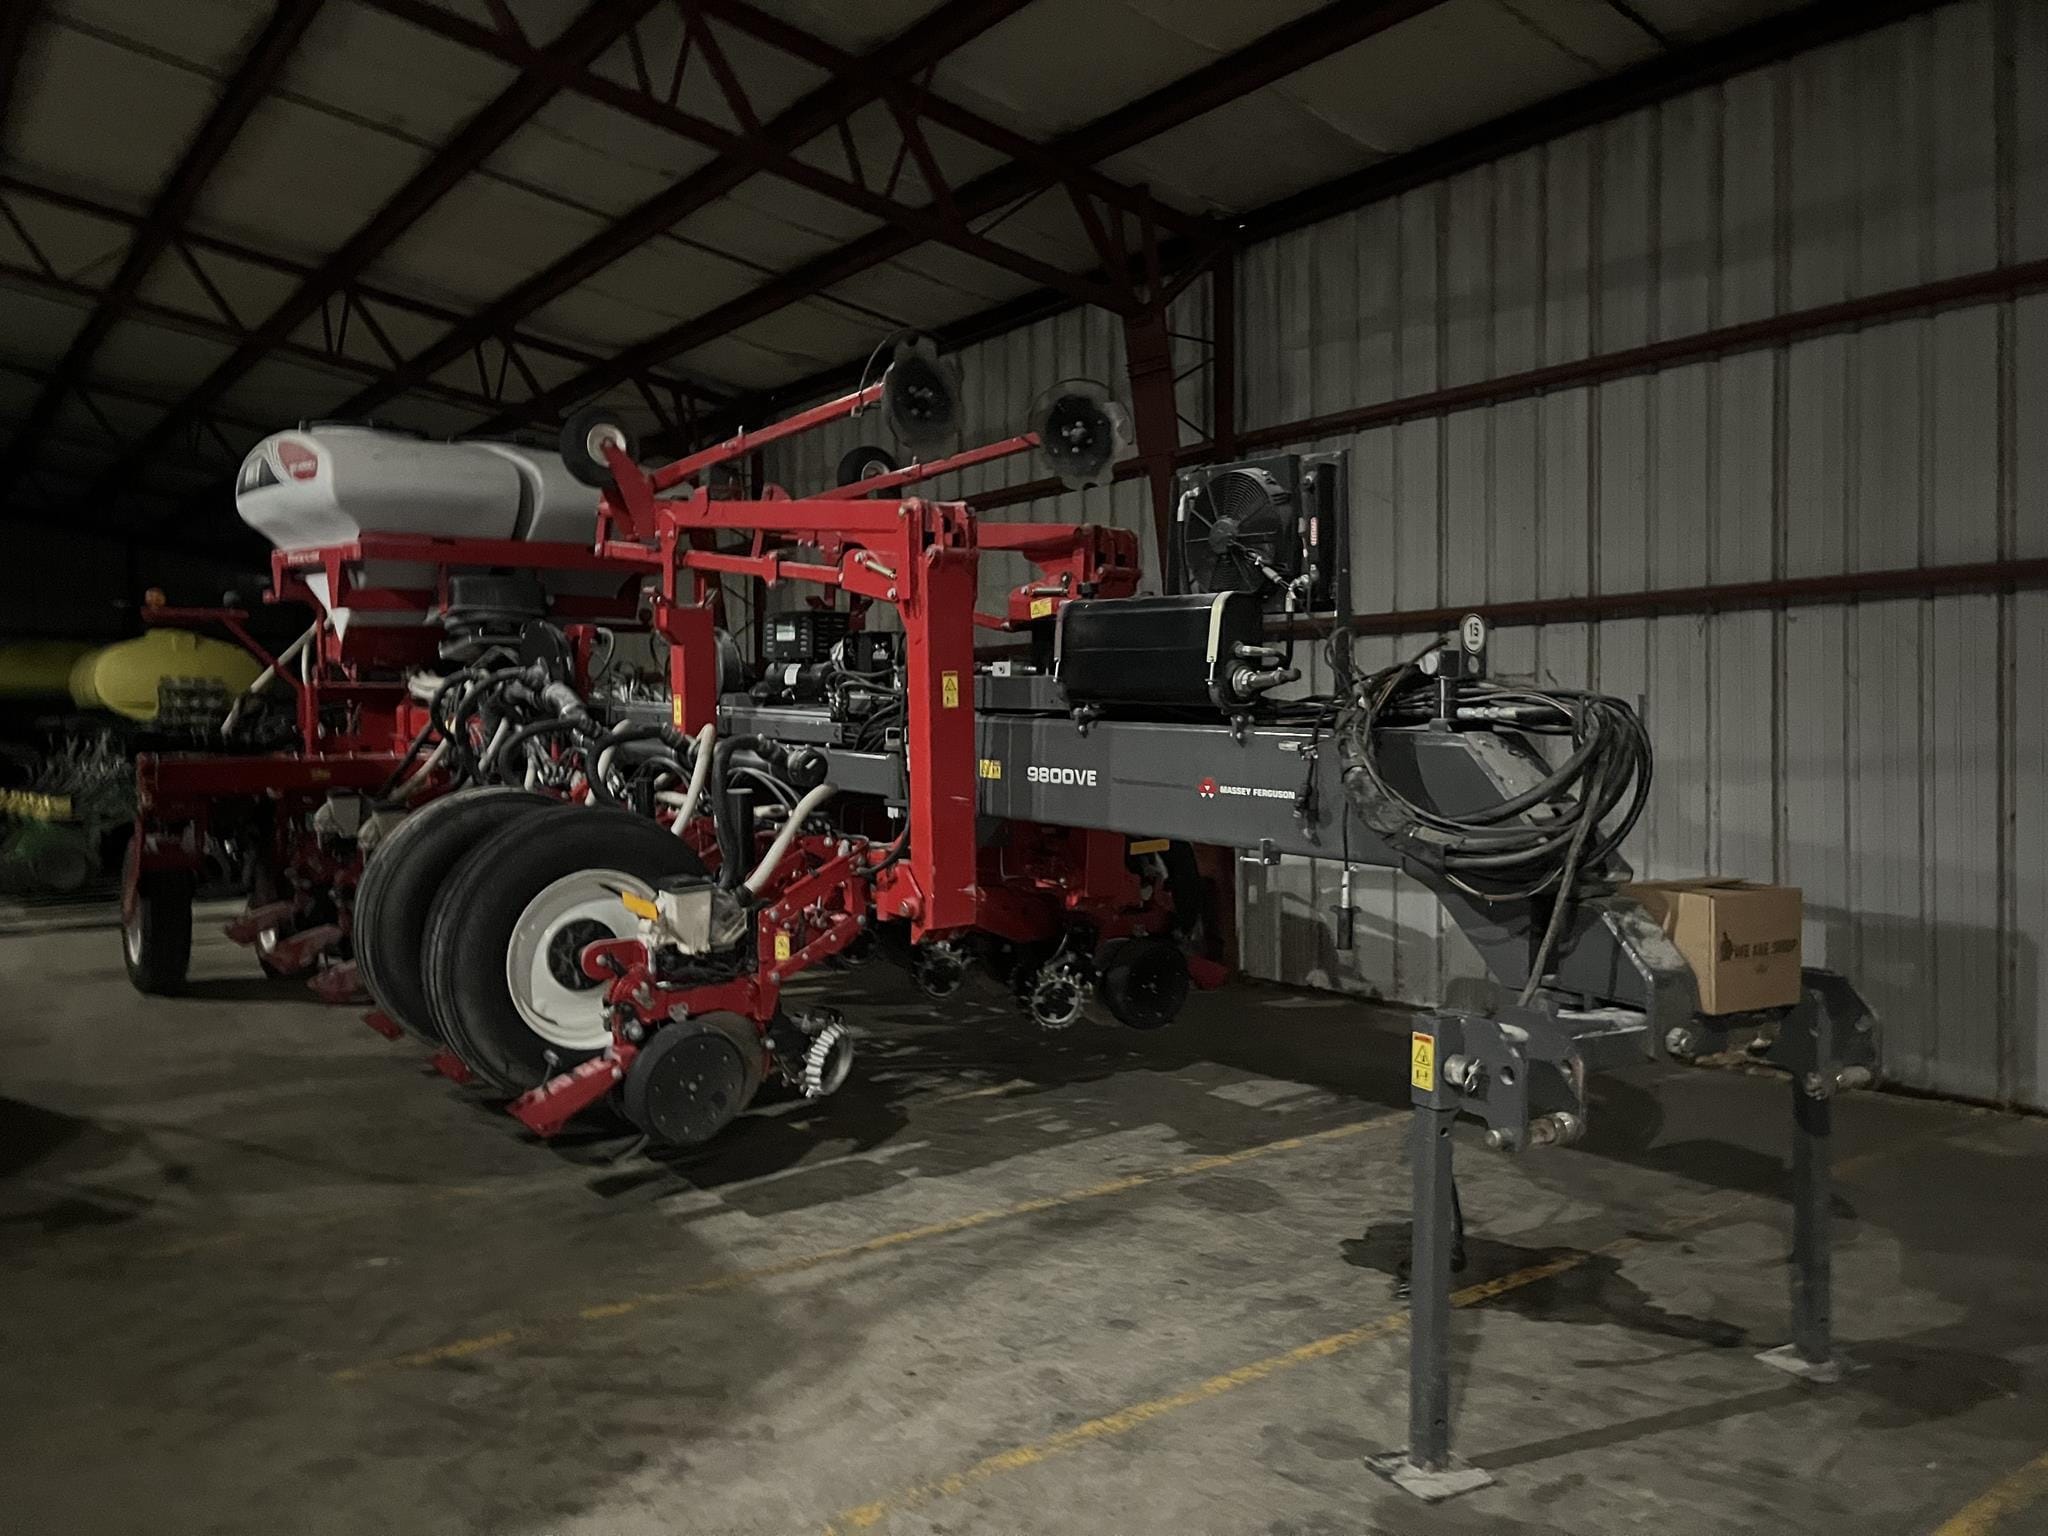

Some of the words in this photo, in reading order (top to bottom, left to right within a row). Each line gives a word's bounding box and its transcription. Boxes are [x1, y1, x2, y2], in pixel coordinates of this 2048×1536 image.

[1469, 622, 1479, 637] 15
[1026, 766, 1097, 787] 9800VE
[1219, 785, 1251, 796] MASSEY
[1252, 788, 1296, 800] FERGUSON
